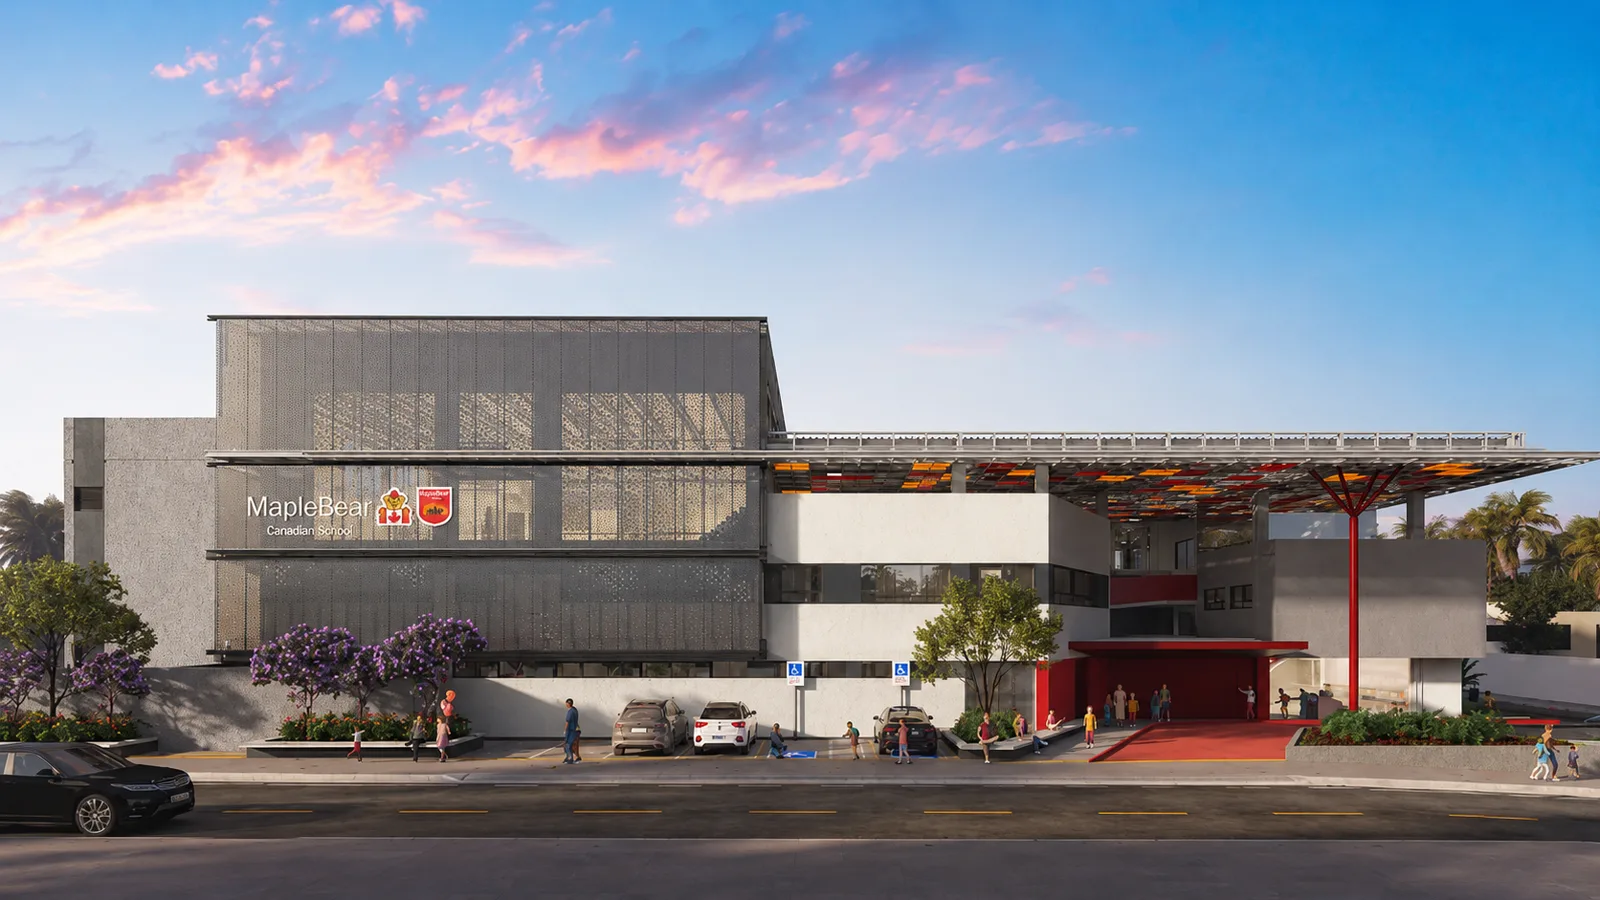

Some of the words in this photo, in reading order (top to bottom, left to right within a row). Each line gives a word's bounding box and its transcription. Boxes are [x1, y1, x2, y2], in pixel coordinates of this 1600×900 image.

[247, 496, 372, 521] MapleBear
[266, 525, 315, 536] Canadian
[318, 524, 353, 536] School
